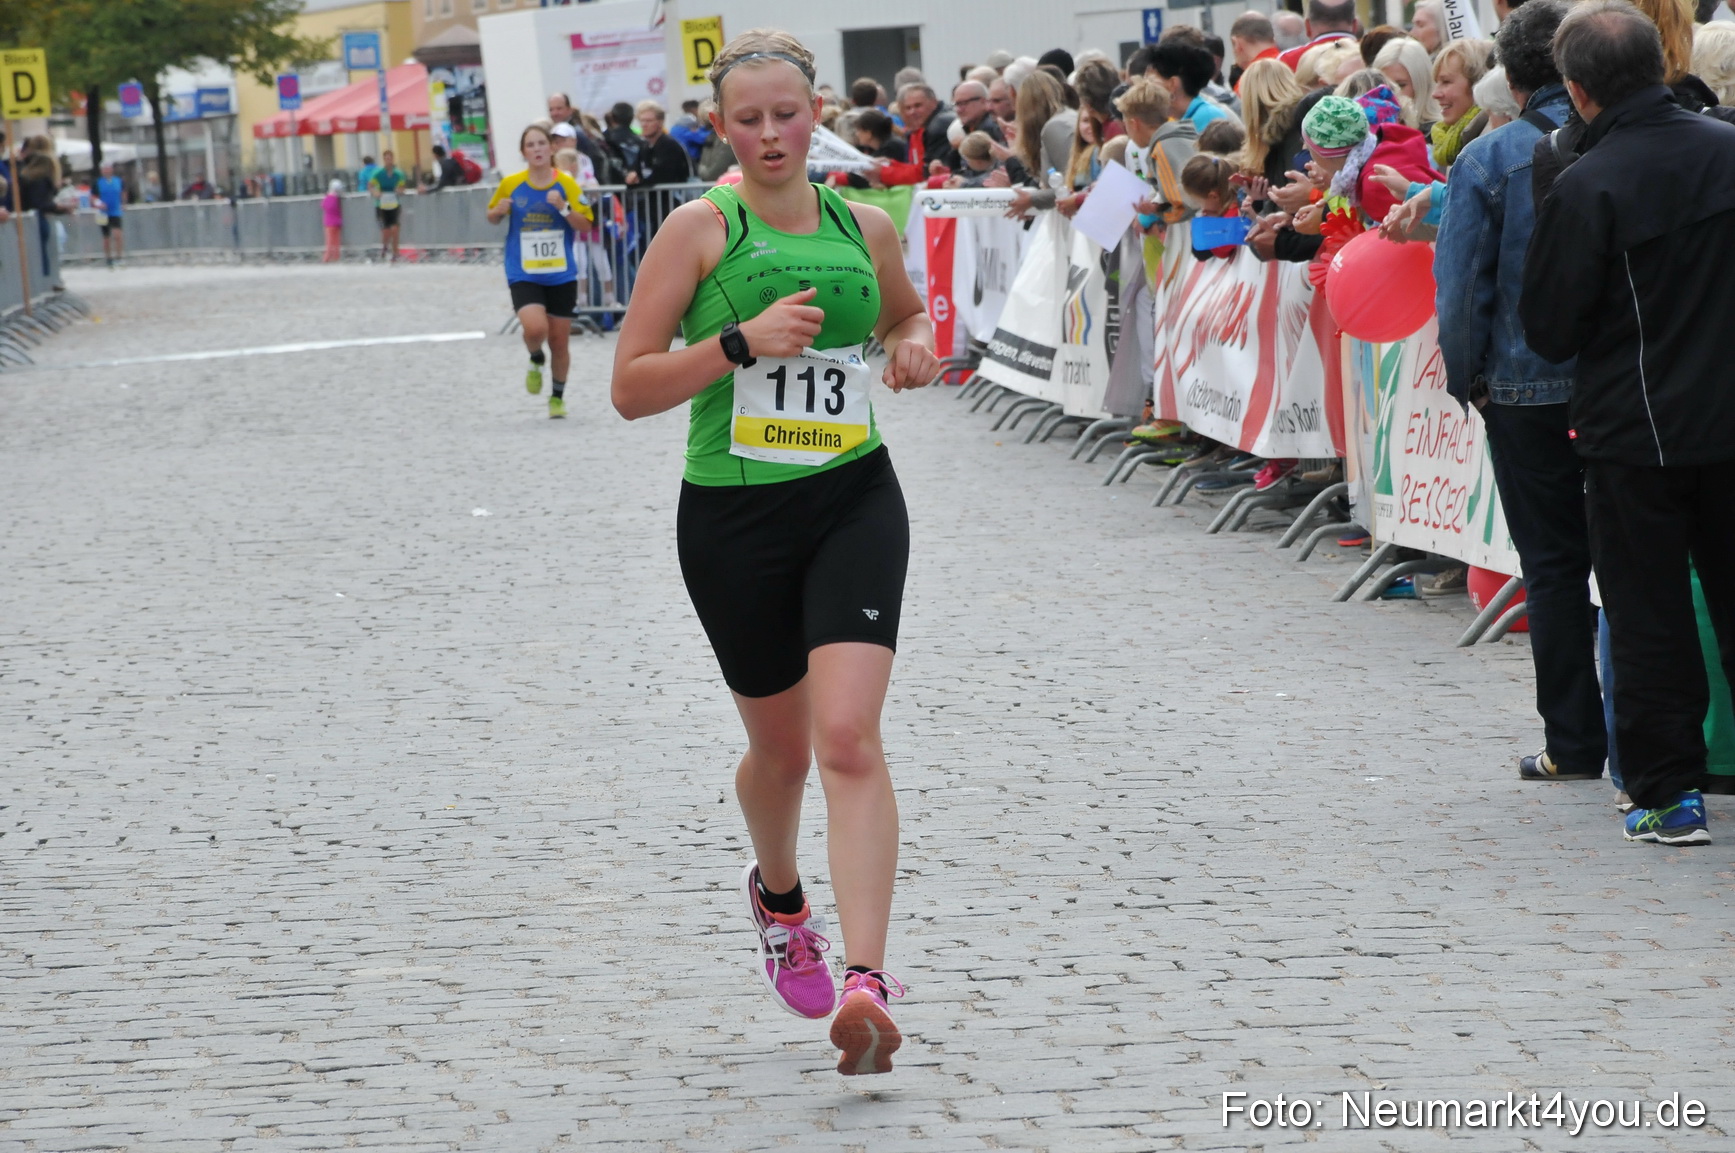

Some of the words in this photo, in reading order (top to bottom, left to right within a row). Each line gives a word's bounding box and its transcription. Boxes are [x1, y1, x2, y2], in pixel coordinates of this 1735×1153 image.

[693, 38, 716, 69] D
[12, 71, 36, 103] D
[531, 242, 558, 258] 102
[750, 248, 778, 259] erima
[746, 265, 811, 283] FESER
[766, 364, 847, 416] 113
[739, 406, 746, 415] C
[764, 424, 842, 448] Christina
[1399, 474, 1467, 534] BESSER
